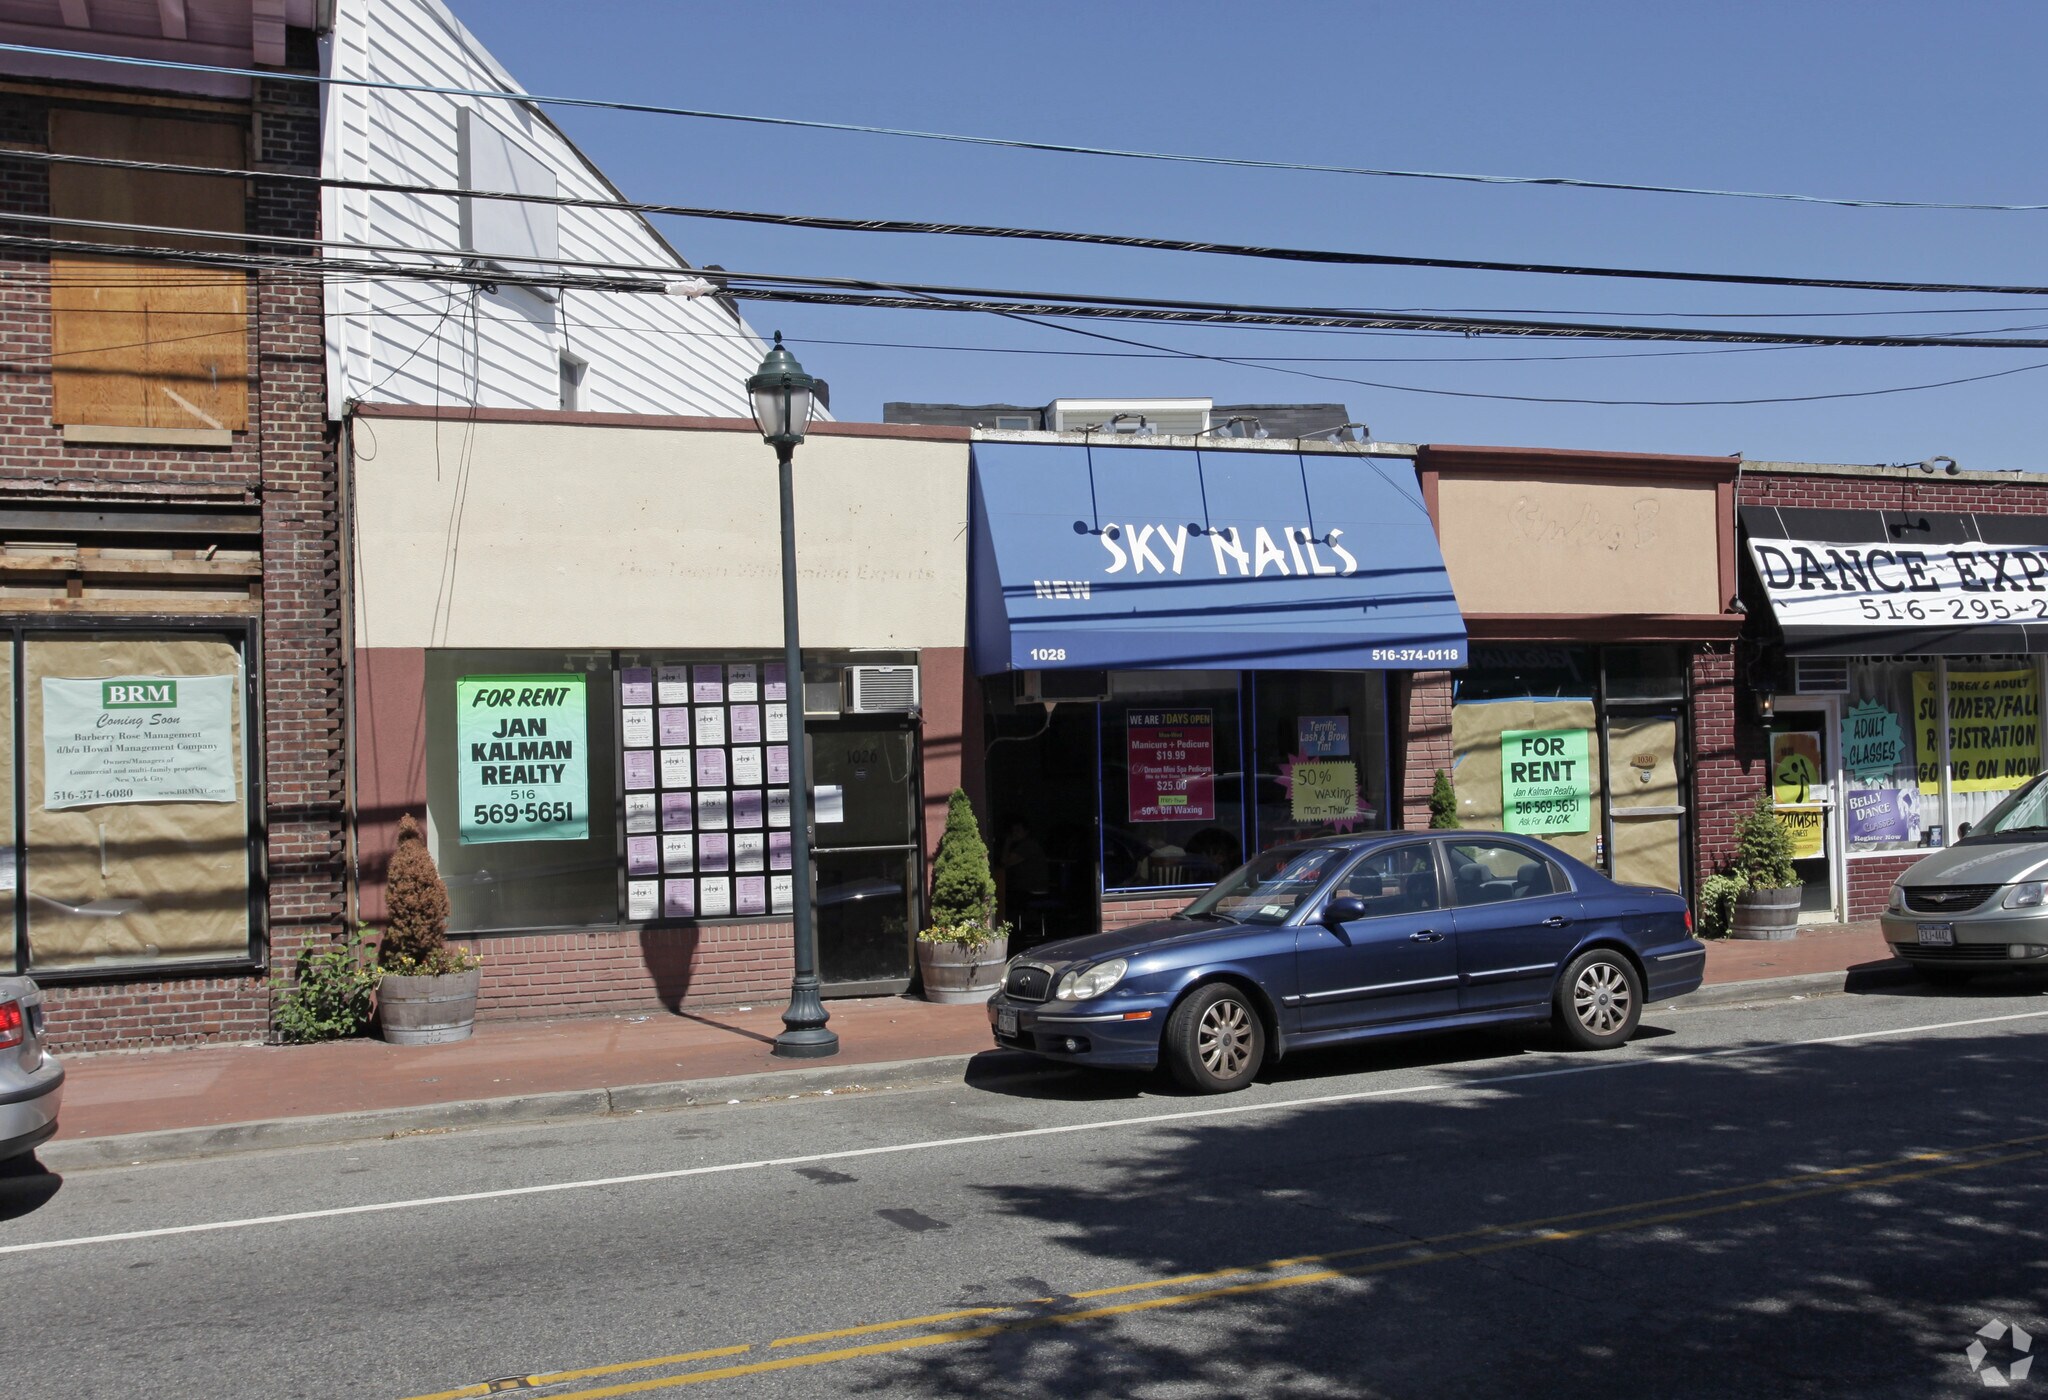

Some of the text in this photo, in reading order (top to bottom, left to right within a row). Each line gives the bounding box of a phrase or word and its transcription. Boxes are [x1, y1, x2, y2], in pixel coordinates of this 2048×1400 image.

[1101, 523, 1358, 578] SKY NAILS
[1755, 545, 2048, 593] DANCE EXP
[1034, 581, 1090, 600] NEW
[1030, 648, 1066, 661] 1028
[1372, 648, 1458, 662] 516-374-0118
[1994, 678, 2028, 690] ADULT
[108, 685, 170, 702] BRM
[472, 687, 571, 708] FOR RENT
[96, 713, 181, 729] Coming Soon
[1130, 715, 1142, 725] WE
[1144, 715, 1159, 725] ARE
[1190, 714, 1210, 724] OPEN
[1311, 721, 1337, 732] Terrific
[492, 718, 547, 739] JAN
[1853, 716, 1885, 740] ADULT
[74, 731, 202, 743] Barberry Rose Management
[1300, 730, 1347, 742] Lash & Brow
[1926, 723, 2036, 753] RGISTRATION
[56, 743, 218, 754] d/b/a Howal Management Company
[471, 741, 573, 762] KALMAN
[1131, 740, 1168, 749] Manicure
[1176, 740, 1210, 749] Pedicure
[1317, 741, 1332, 752] Tint
[1521, 737, 1565, 757] FOR
[1156, 750, 1186, 760] $19.99
[1637, 756, 1653, 764] 1030
[1849, 741, 1896, 767] CLASSES
[481, 763, 566, 786] REALTY
[1511, 760, 1577, 784] RENT
[1919, 757, 2040, 783] GONG ON NOW
[150, 775, 163, 783] City
[1156, 781, 1187, 791] $25.00
[53, 788, 134, 801] 516-374-6080
[510, 789, 536, 800] 516
[1513, 785, 1578, 797] Jan Kalman Realty
[1515, 799, 1579, 815] 516-569-5651
[1849, 791, 1882, 810] BELLY
[1141, 804, 1203, 817] 50% Off Waxing
[1856, 802, 1892, 821] DANCE
[1544, 814, 1571, 825] RICK
[1863, 817, 1896, 833] CLASSES
[1854, 834, 1883, 842] Register
